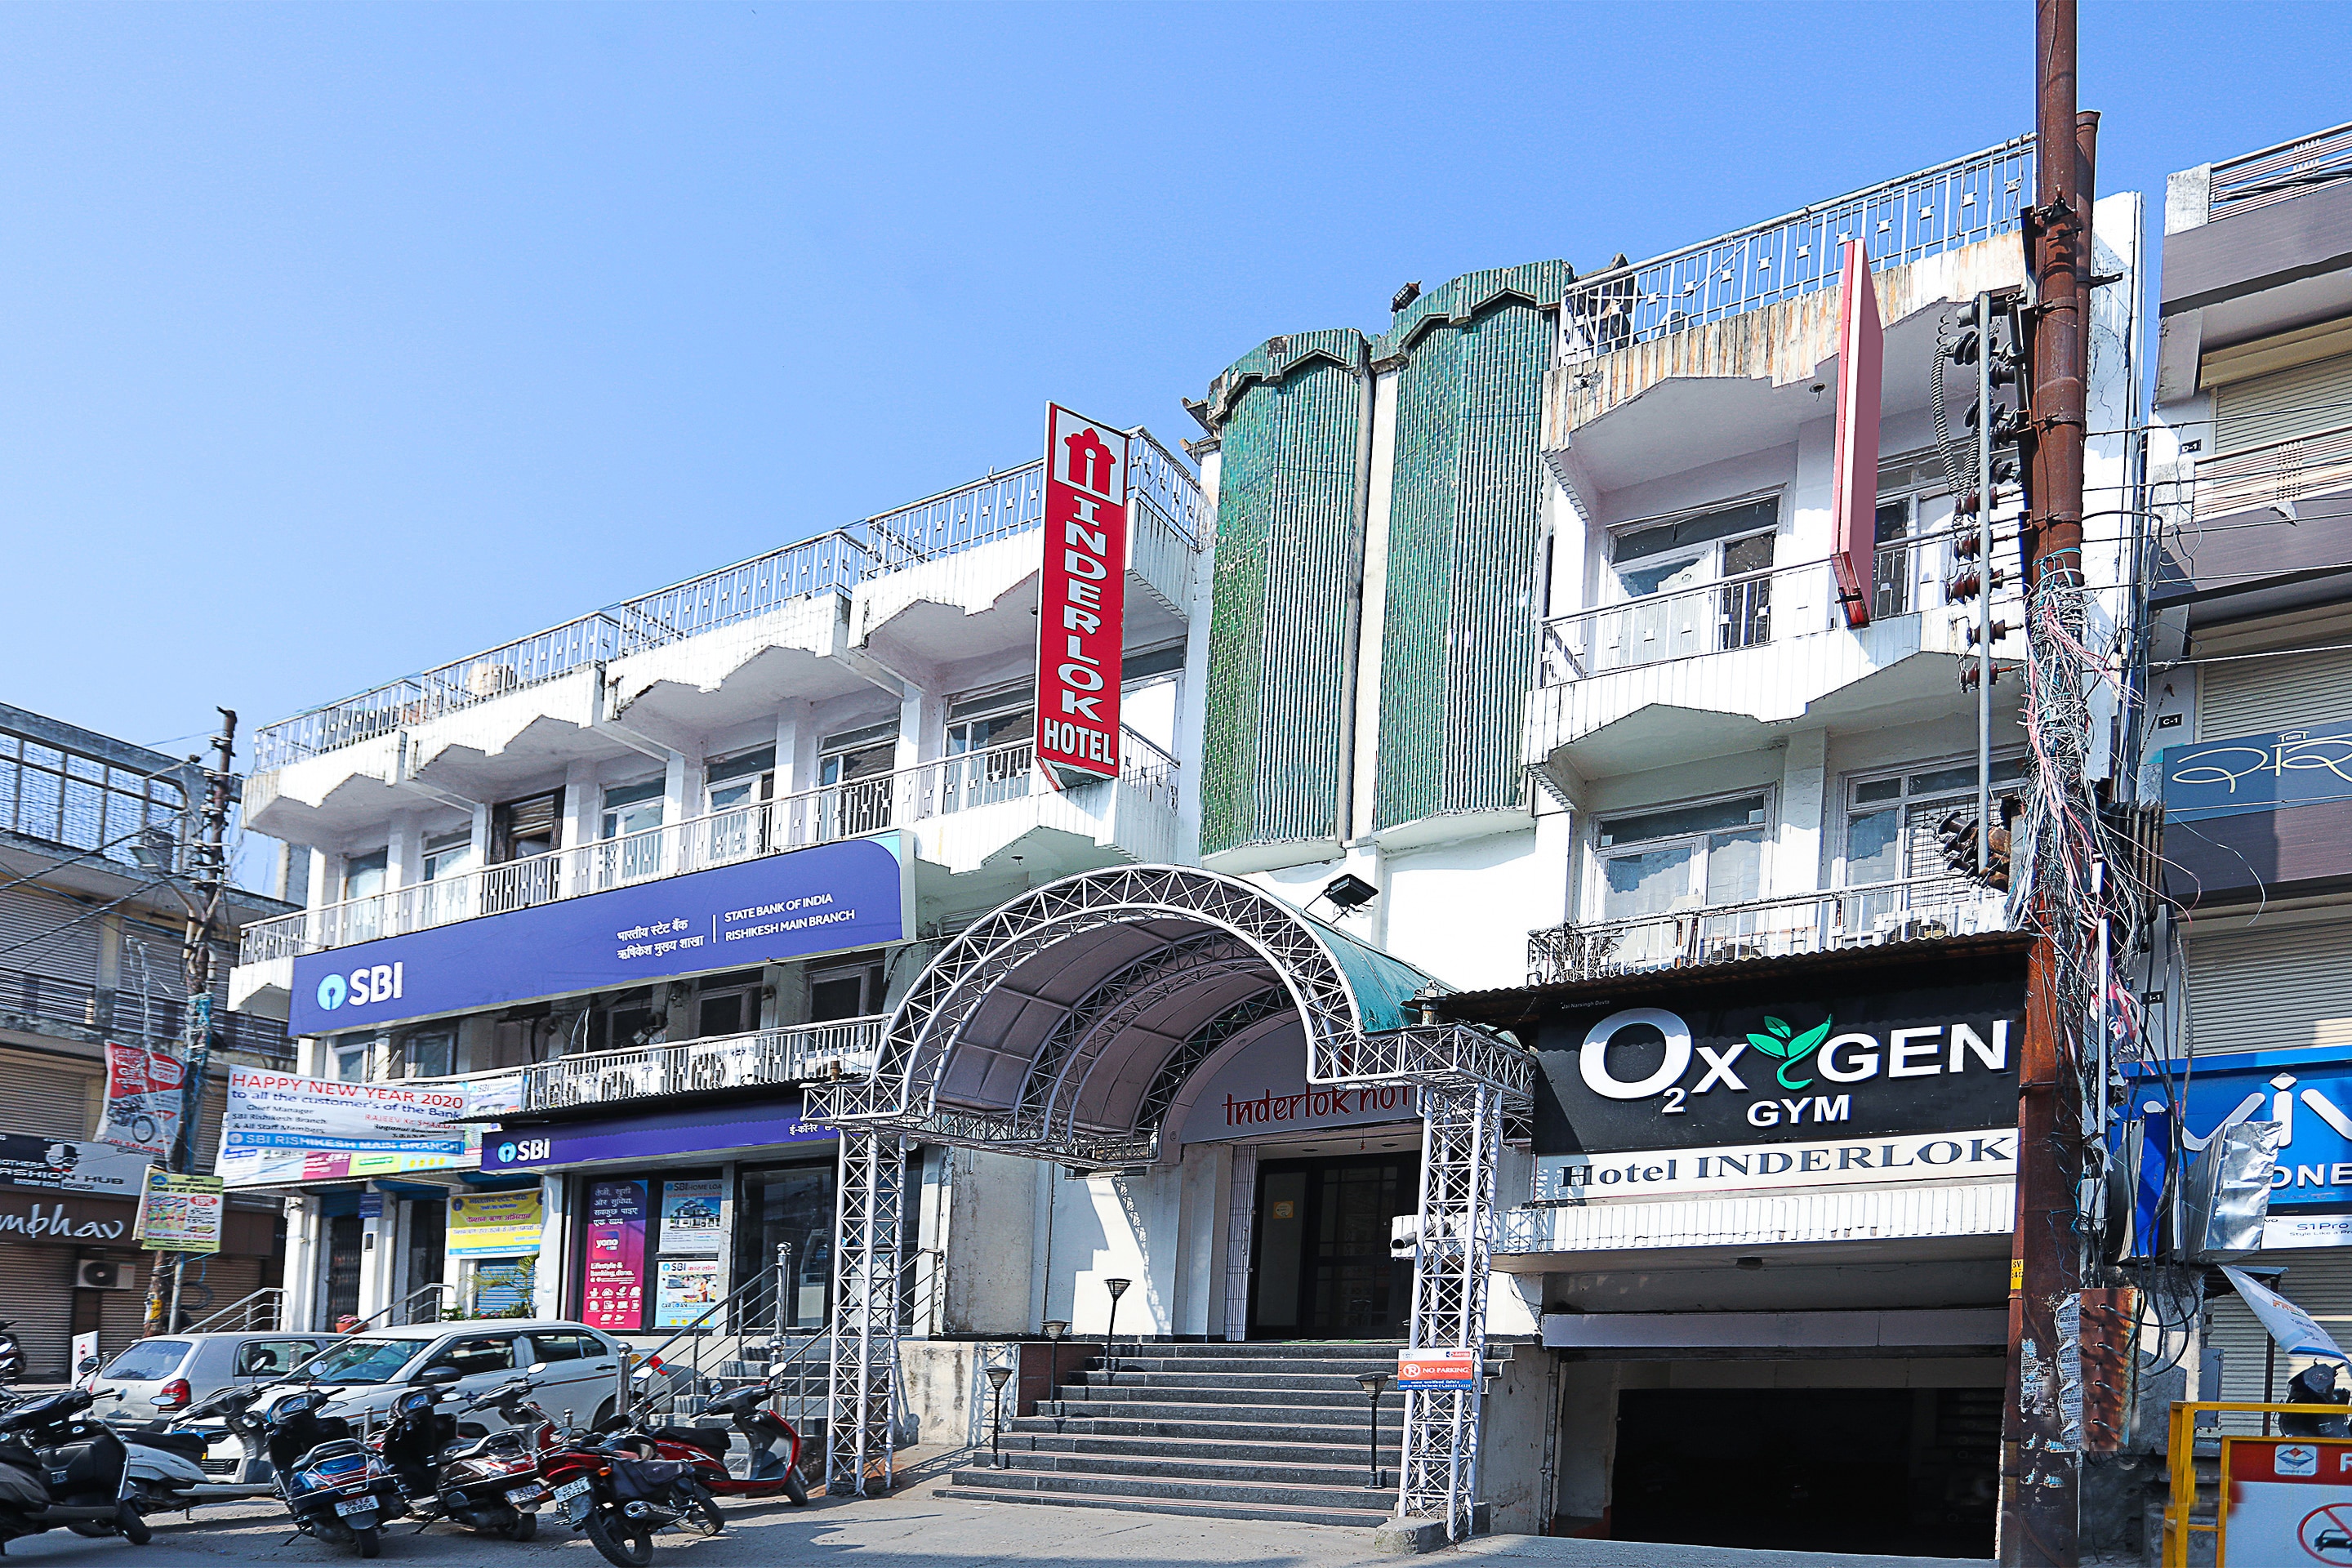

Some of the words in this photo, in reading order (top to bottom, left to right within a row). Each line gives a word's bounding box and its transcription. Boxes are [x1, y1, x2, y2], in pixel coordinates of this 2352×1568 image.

[2182, 443, 2198, 453] D-1
[1057, 494, 1107, 724] INDERLOK
[2163, 717, 2179, 725] C-1
[1043, 717, 1115, 766] HOTEL
[724, 909, 755, 923] STATE
[756, 903, 785, 917] BANK
[786, 899, 802, 911] OF
[803, 893, 833, 907] INDIA
[617, 925, 648, 942] भारतीय
[651, 921, 670, 936] स्टेट
[671, 918, 689, 932] बैंक
[725, 925, 777, 941] RISHIKESH
[780, 918, 807, 932] MAIN
[808, 909, 855, 925] BRANCH
[617, 944, 652, 960] ऋषिकेश
[654, 940, 677, 957] मुख्य
[679, 934, 704, 950] शाखा
[347, 961, 403, 1006] SBI
[231, 1074, 302, 1091] HAPPY
[310, 1080, 359, 1096] NEW
[364, 1086, 415, 1102] YEAR
[421, 1094, 463, 1109] 2020
[231, 1090, 247, 1098] to
[252, 1091, 268, 1099] all
[274, 1094, 296, 1102] the
[302, 1097, 379, 1109] customer's
[385, 1102, 397, 1111] of
[403, 1105, 424, 1115] the
[429, 1108, 462, 1119] Bank
[274, 1106, 314, 1114] Manager
[1746, 1094, 1851, 1127] GYM
[250, 1114, 292, 1123] Rishikesh
[296, 1116, 327, 1125] Branch
[246, 1134, 270, 1143] SBI
[275, 1134, 356, 1148] RISHIKESH
[359, 1141, 395, 1149] MAIN
[399, 1142, 459, 1151] BRANCH
[517, 1138, 550, 1161] SBI
[0, 1160, 46, 1169] OTHERS
[1561, 1158, 1677, 1188] Hotel
[1696, 1136, 2015, 1179] INDERLOK
[84, 1175, 124, 1185] HUB
[674, 1183, 688, 1191] SBI
[595, 1238, 619, 1248] yono
[671, 1263, 686, 1272] SBI
